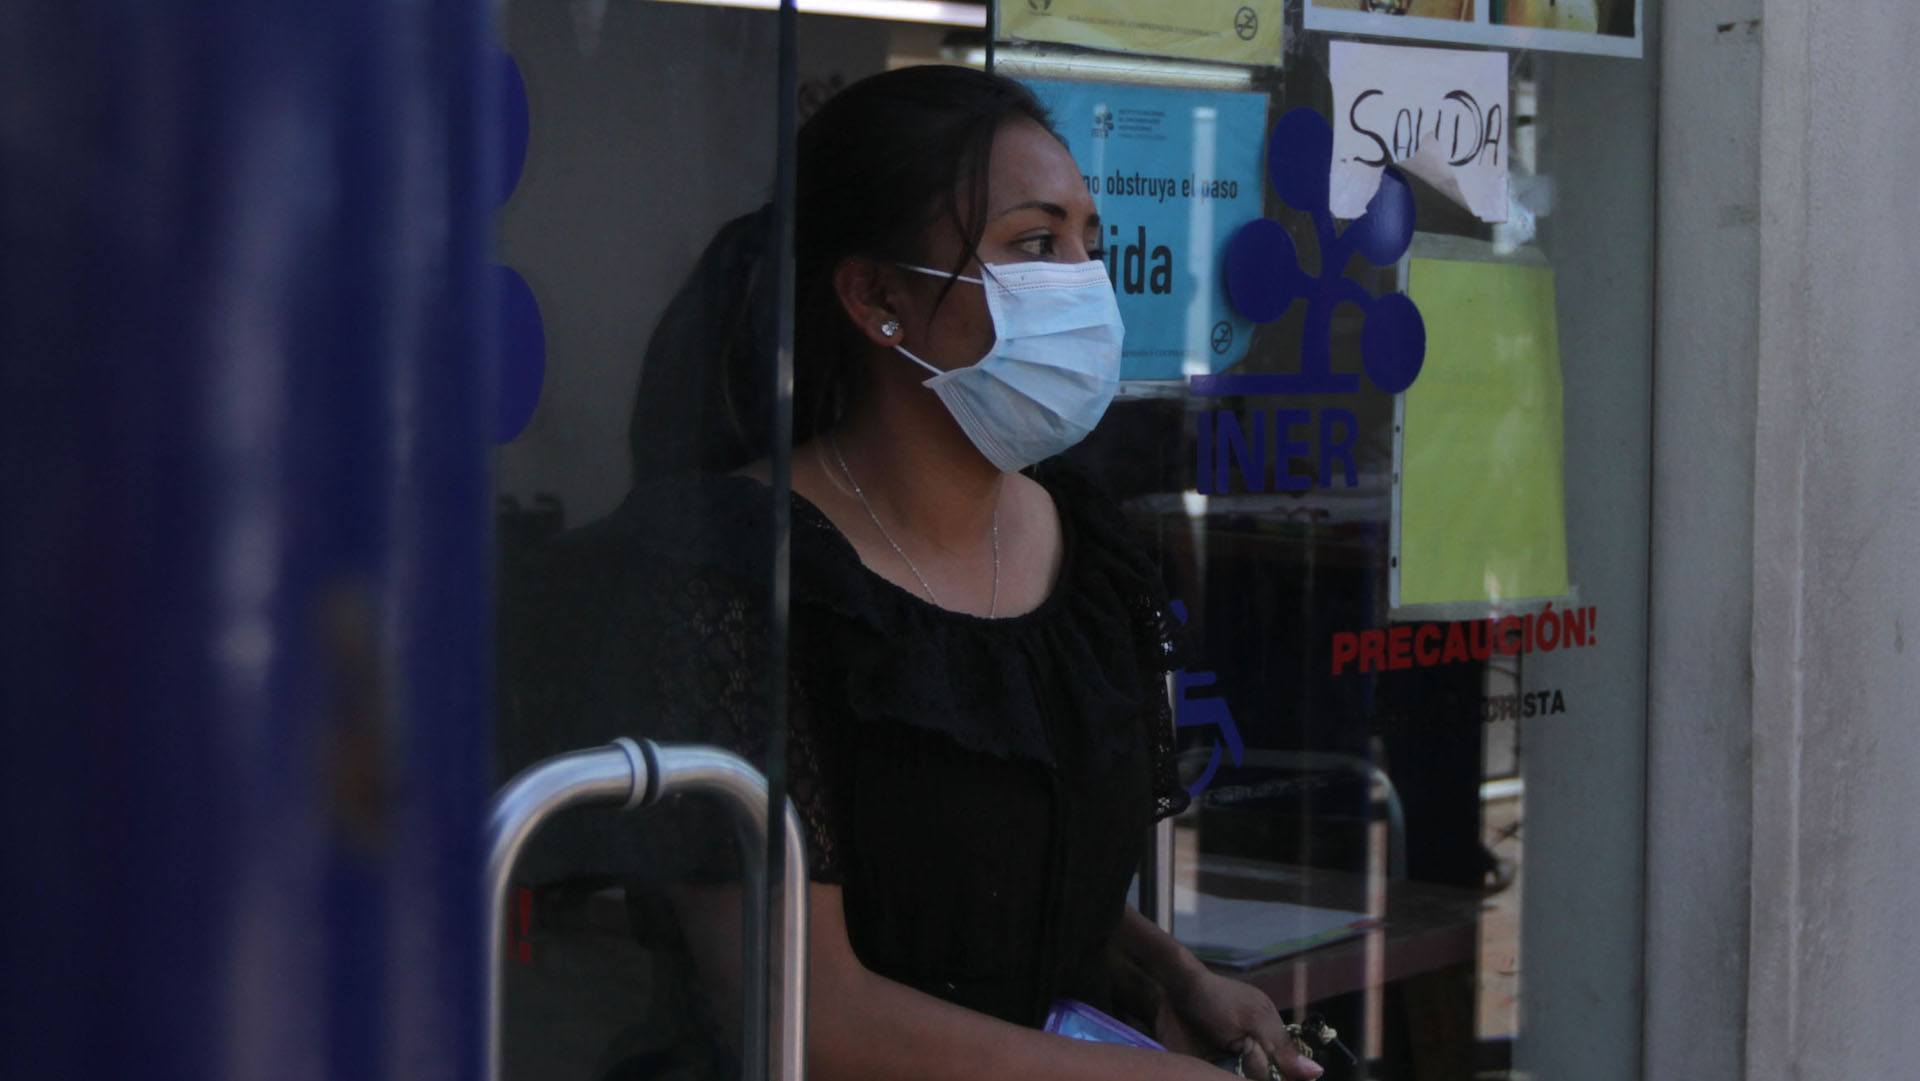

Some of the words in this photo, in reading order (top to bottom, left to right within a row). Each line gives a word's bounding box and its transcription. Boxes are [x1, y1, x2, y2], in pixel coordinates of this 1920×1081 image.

[1106, 169, 1176, 203] obstruya
[1181, 172, 1196, 198] el
[1200, 179, 1238, 205] paso
[1197, 408, 1360, 495] INER
[1331, 602, 1598, 676] PRECAUCIÓN!
